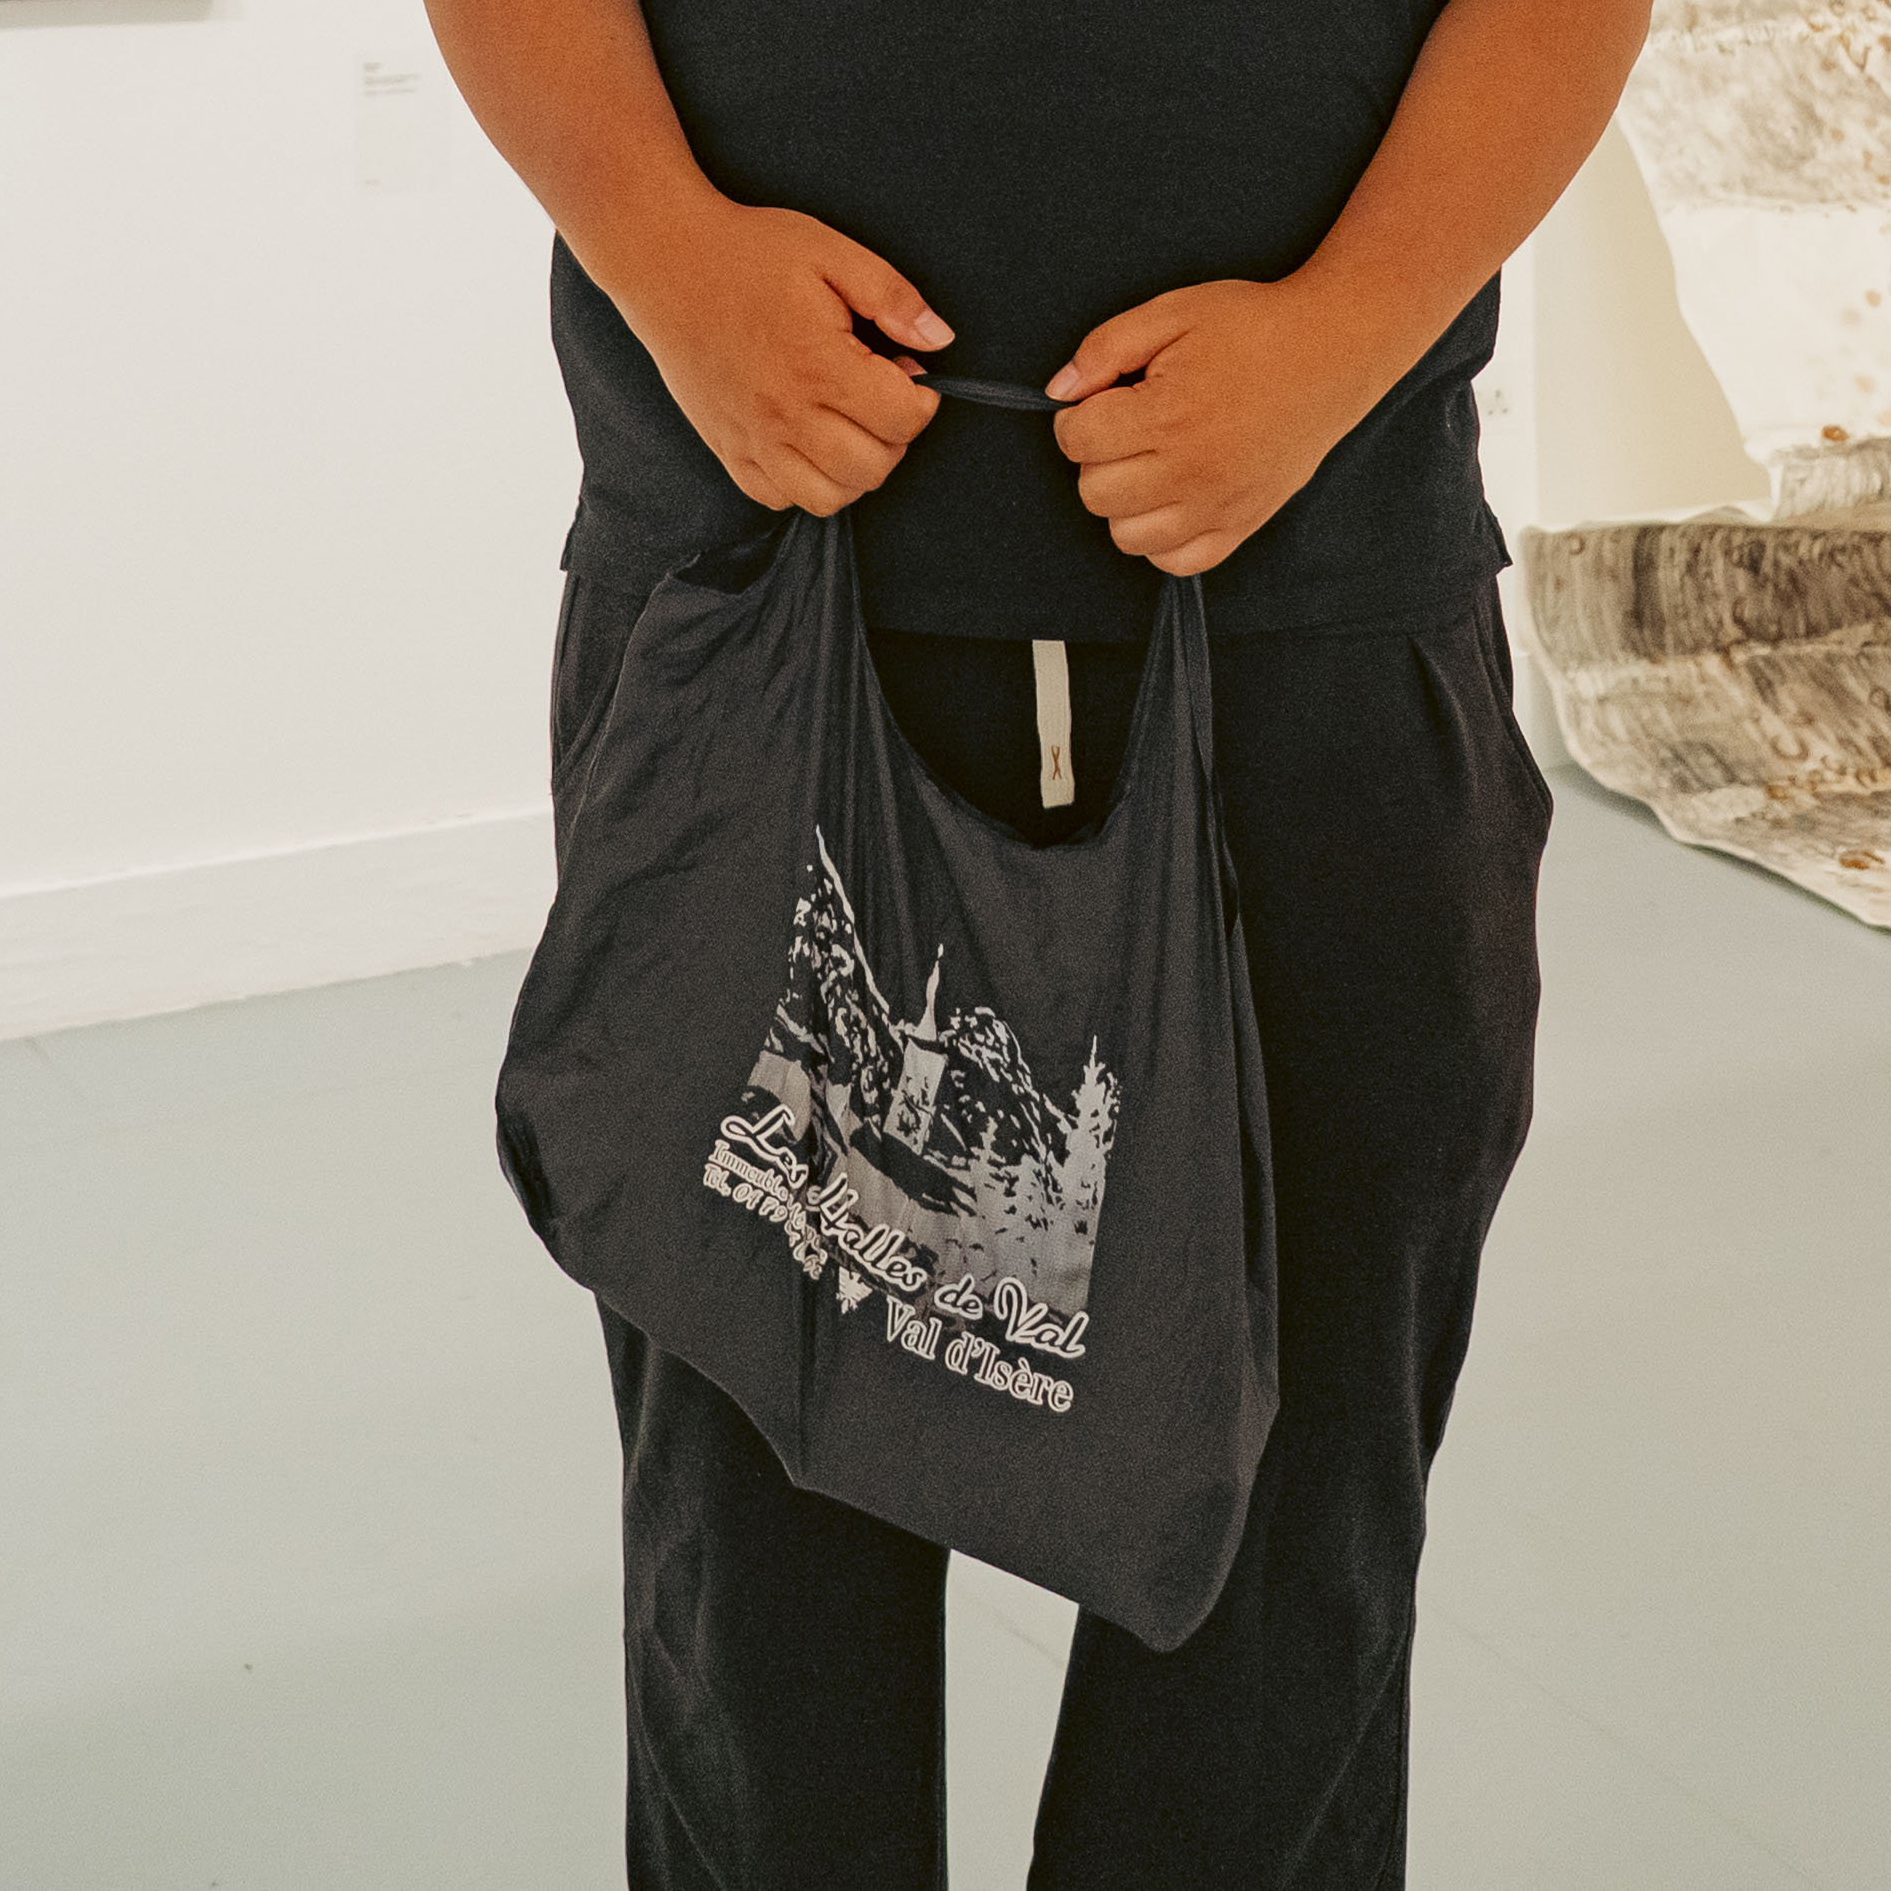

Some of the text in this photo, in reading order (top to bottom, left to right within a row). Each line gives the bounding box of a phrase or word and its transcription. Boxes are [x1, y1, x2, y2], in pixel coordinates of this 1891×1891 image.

[720, 1104, 809, 1189] Les
[933, 1273, 983, 1320] de
[993, 1277, 1089, 1359] Val
[885, 1295, 1074, 1413] Val d'Isère
